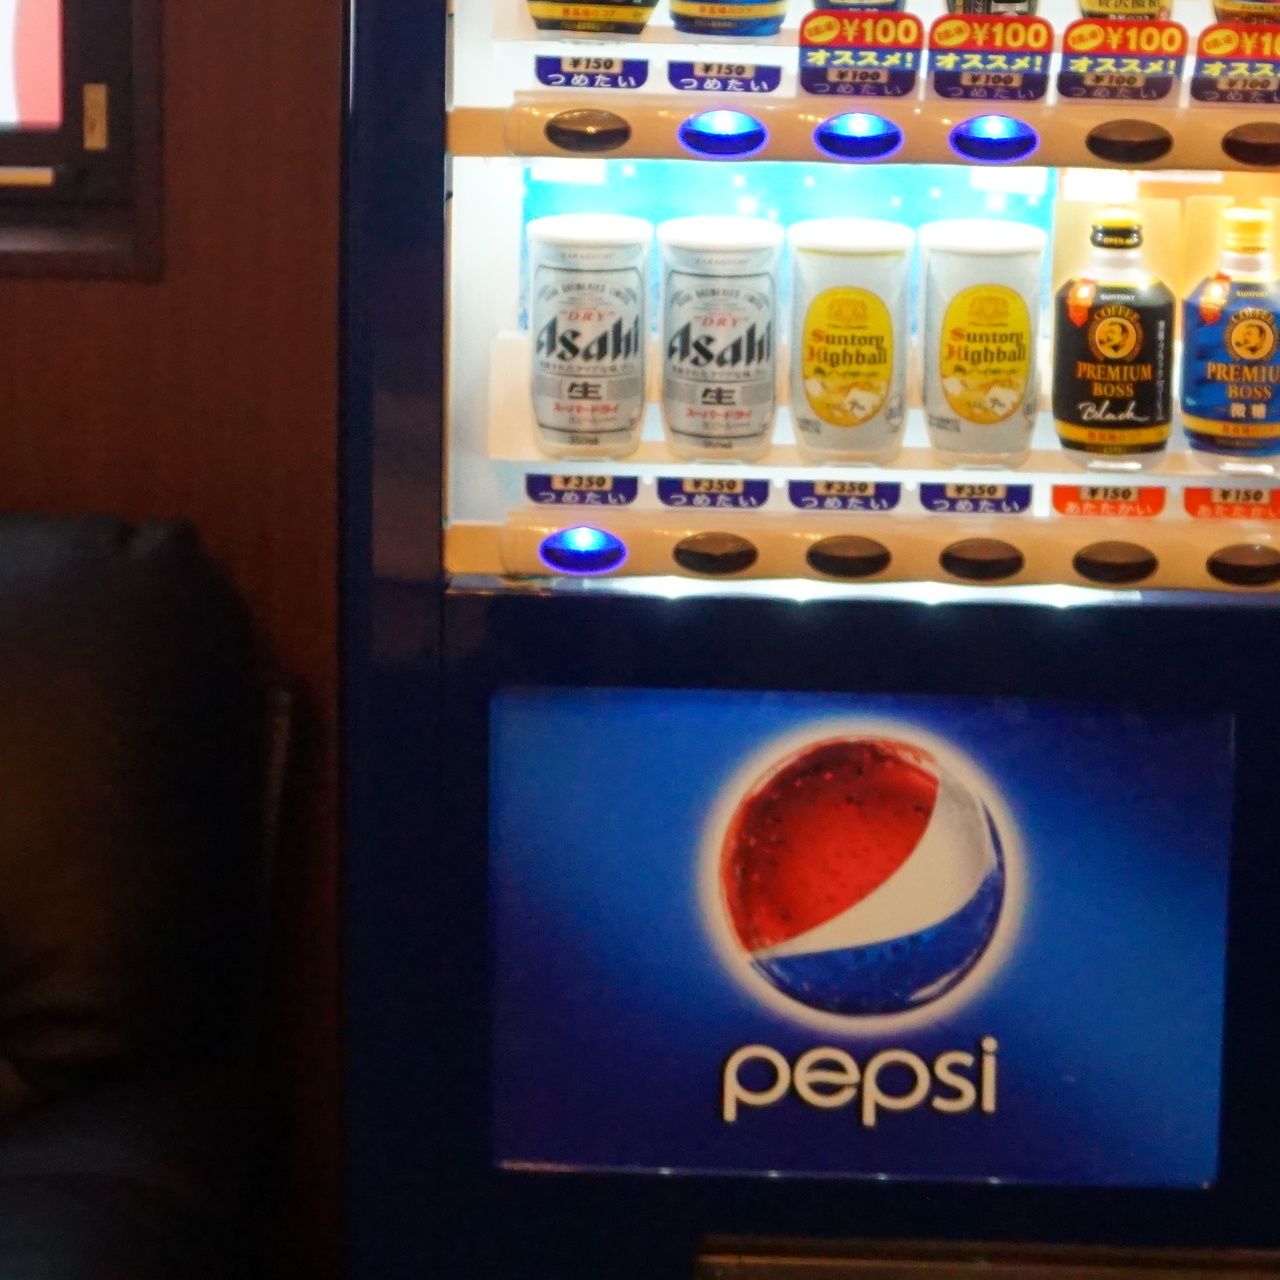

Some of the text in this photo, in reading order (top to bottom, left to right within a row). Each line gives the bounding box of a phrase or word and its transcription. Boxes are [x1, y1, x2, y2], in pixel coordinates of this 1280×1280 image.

[843, 18, 918, 43] ¥100
[972, 22, 1048, 48] ¥100
[1107, 26, 1180, 52] ¥100
[570, 57, 613, 71] ¥150
[807, 50, 913, 68] オススメ!
[936, 53, 1043, 71] オススメ!
[1070, 57, 1176, 74] オススメ!
[703, 63, 746, 76] ¥150
[547, 74, 638, 88] つめたい
[680, 77, 769, 92] つめたい
[536, 314, 640, 362] Asahi
[668, 321, 771, 368] Asahi
[811, 328, 885, 349] Suntory
[949, 327, 1024, 348] Suntory
[804, 345, 887, 368] Highball
[944, 343, 1026, 367] Highball
[1075, 361, 1152, 382] PREMIUM
[567, 381, 603, 401] 生
[701, 387, 736, 406] 生
[1092, 382, 1135, 398] BOSS
[1227, 384, 1272, 400] BOSS
[1078, 400, 1150, 422] Black
[537, 491, 627, 504] つめたい
[669, 494, 757, 507] つめたい
[800, 496, 889, 509] つめたい
[1087, 487, 1132, 500] ¥150
[1220, 489, 1264, 502] ¥150
[932, 500, 1020, 513] つめたい
[723, 1034, 999, 1128] pepsi
